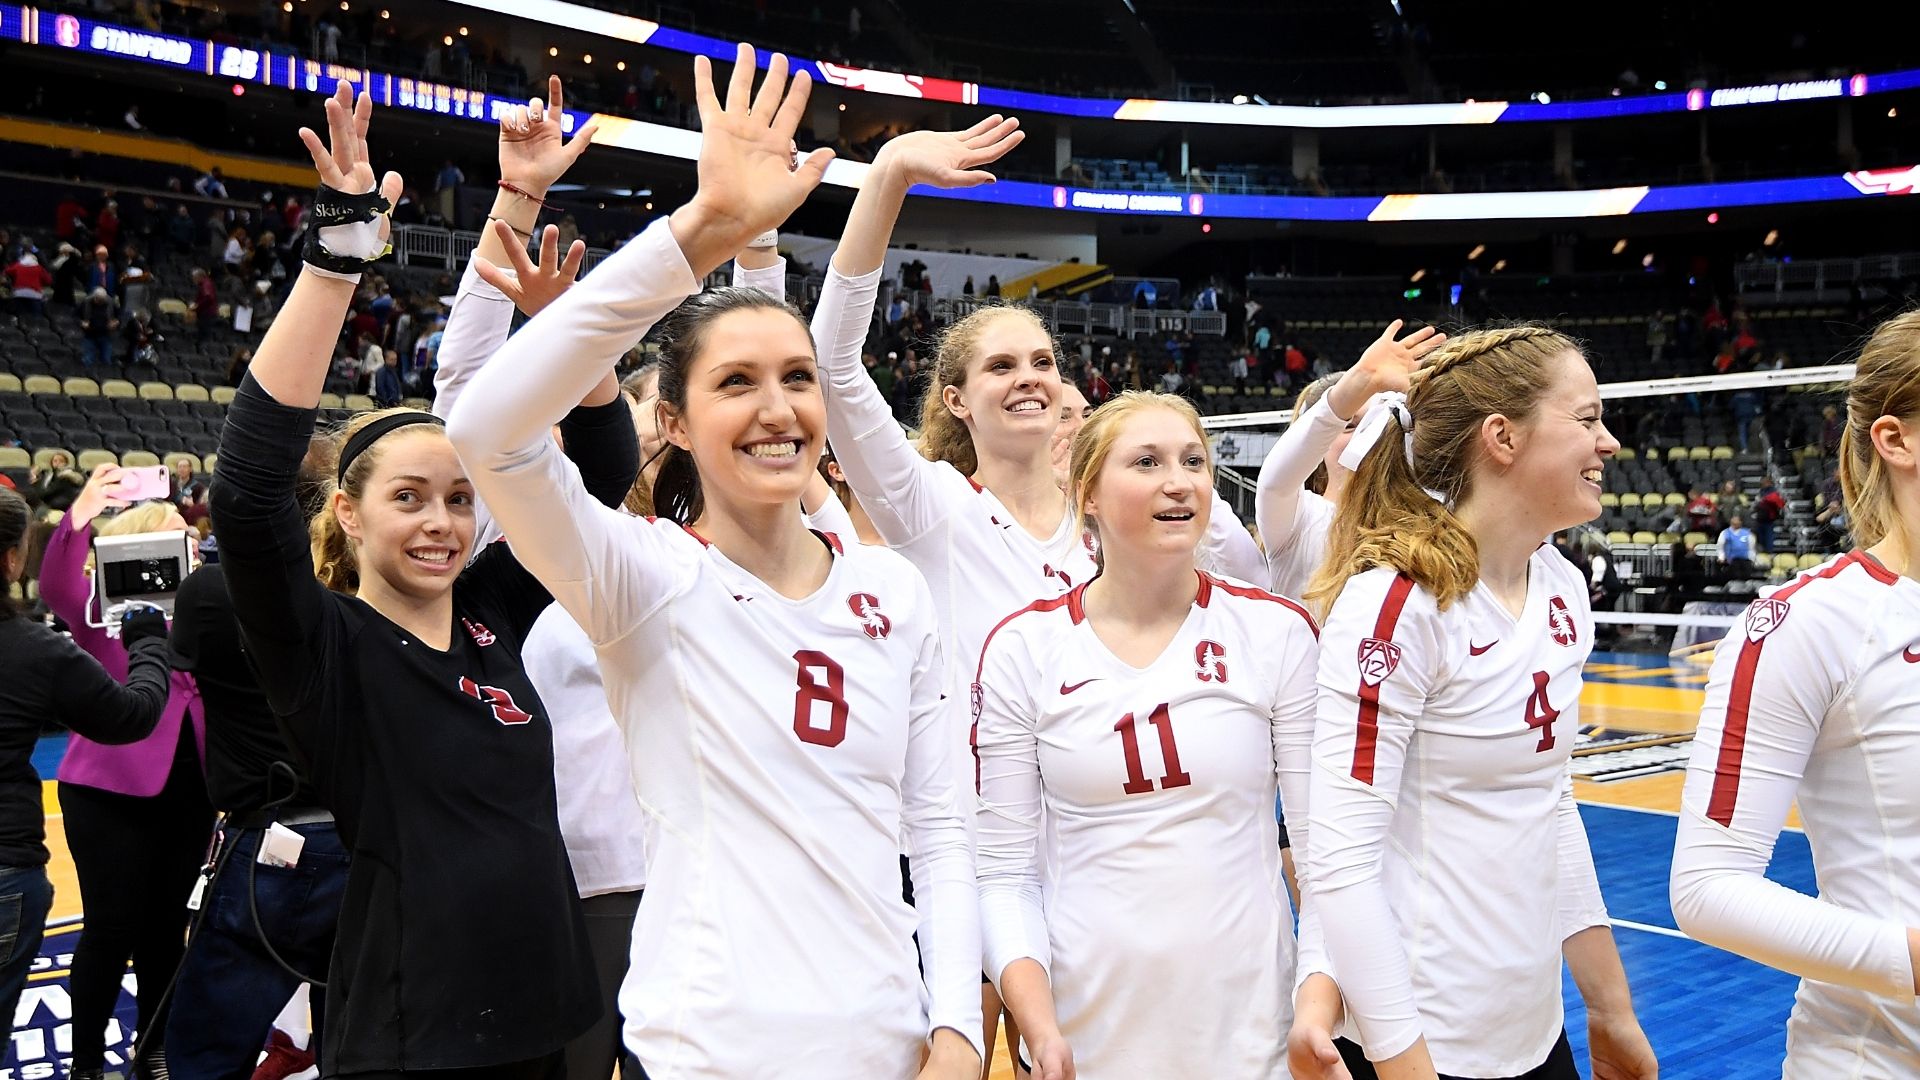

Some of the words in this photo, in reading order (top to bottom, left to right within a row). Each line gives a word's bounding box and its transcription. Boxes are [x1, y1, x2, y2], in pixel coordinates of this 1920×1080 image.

[90, 26, 192, 65] STANFORD
[219, 46, 260, 79] 25
[1711, 84, 1778, 106] STANFORD
[1777, 79, 1843, 100] CARDINAL
[315, 203, 354, 218] Skids
[1072, 191, 1129, 210] STANFORD
[1160, 318, 1183, 331] 115
[1749, 616, 1771, 633] 12
[1363, 659, 1386, 678] 12
[792, 649, 850, 748] 8
[1524, 670, 1561, 753] 4
[1113, 702, 1192, 795] 11
